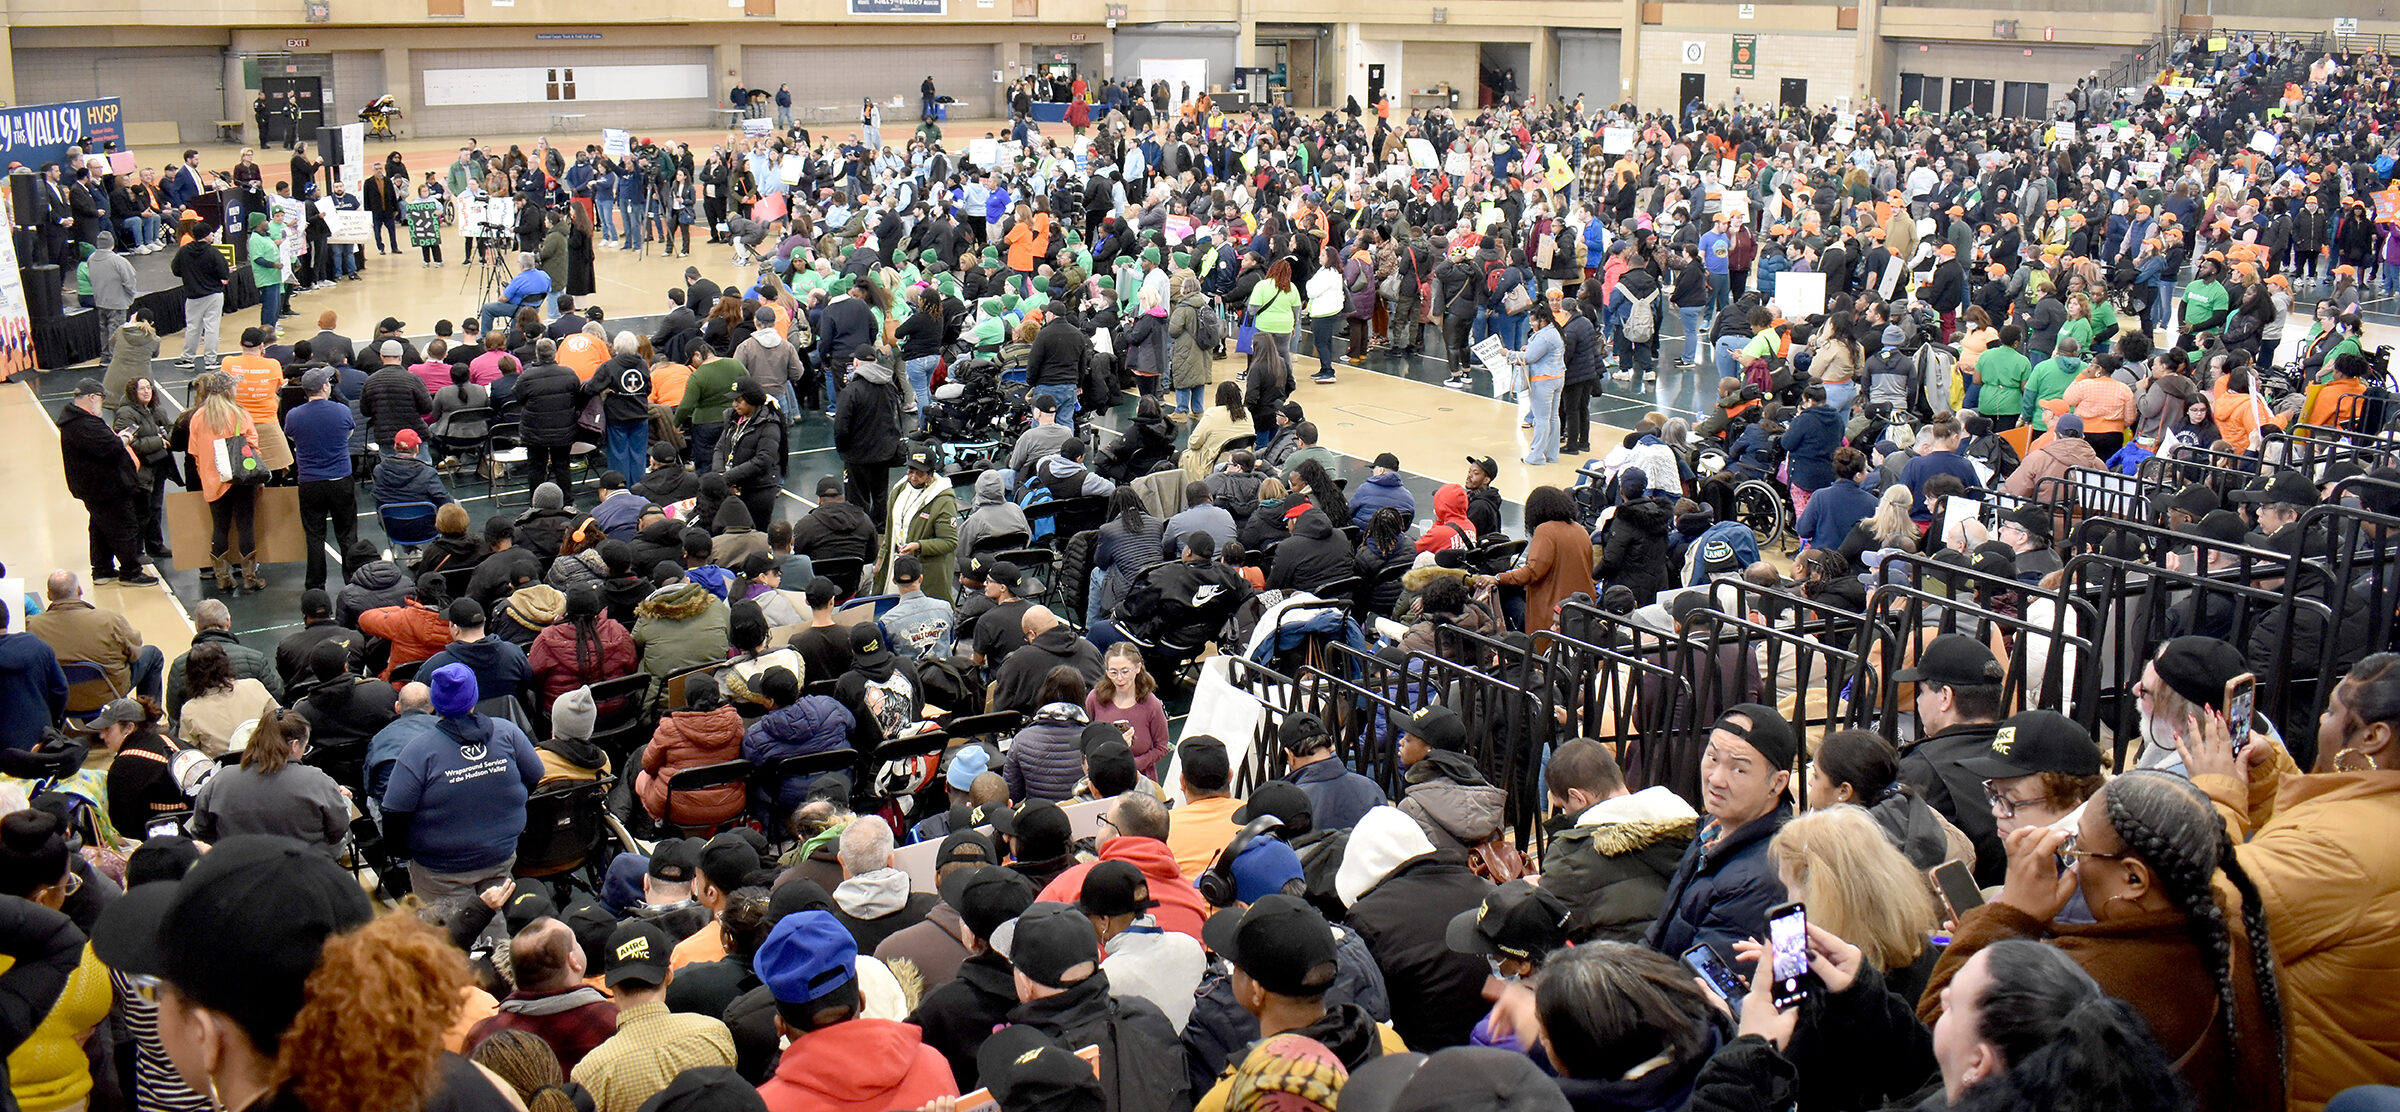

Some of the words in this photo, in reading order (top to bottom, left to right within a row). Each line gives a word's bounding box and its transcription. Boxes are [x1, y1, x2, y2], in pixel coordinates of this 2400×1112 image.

[287, 39, 307, 47] EXIT
[87, 104, 119, 125] HVSP
[14, 116, 22, 130] IN
[24, 107, 82, 148] VALLEY
[13, 130, 27, 144] THE
[420, 238, 437, 246] DSP
[1197, 584, 1220, 598] NIKE
[1992, 744, 2011, 755] NYC
[445, 762, 483, 777] Wraparound
[483, 758, 508, 768] Services
[465, 769, 488, 780] Hudson
[488, 765, 507, 774] Valley
[620, 939, 646, 956] AHRC
[631, 951, 650, 959] NYC
